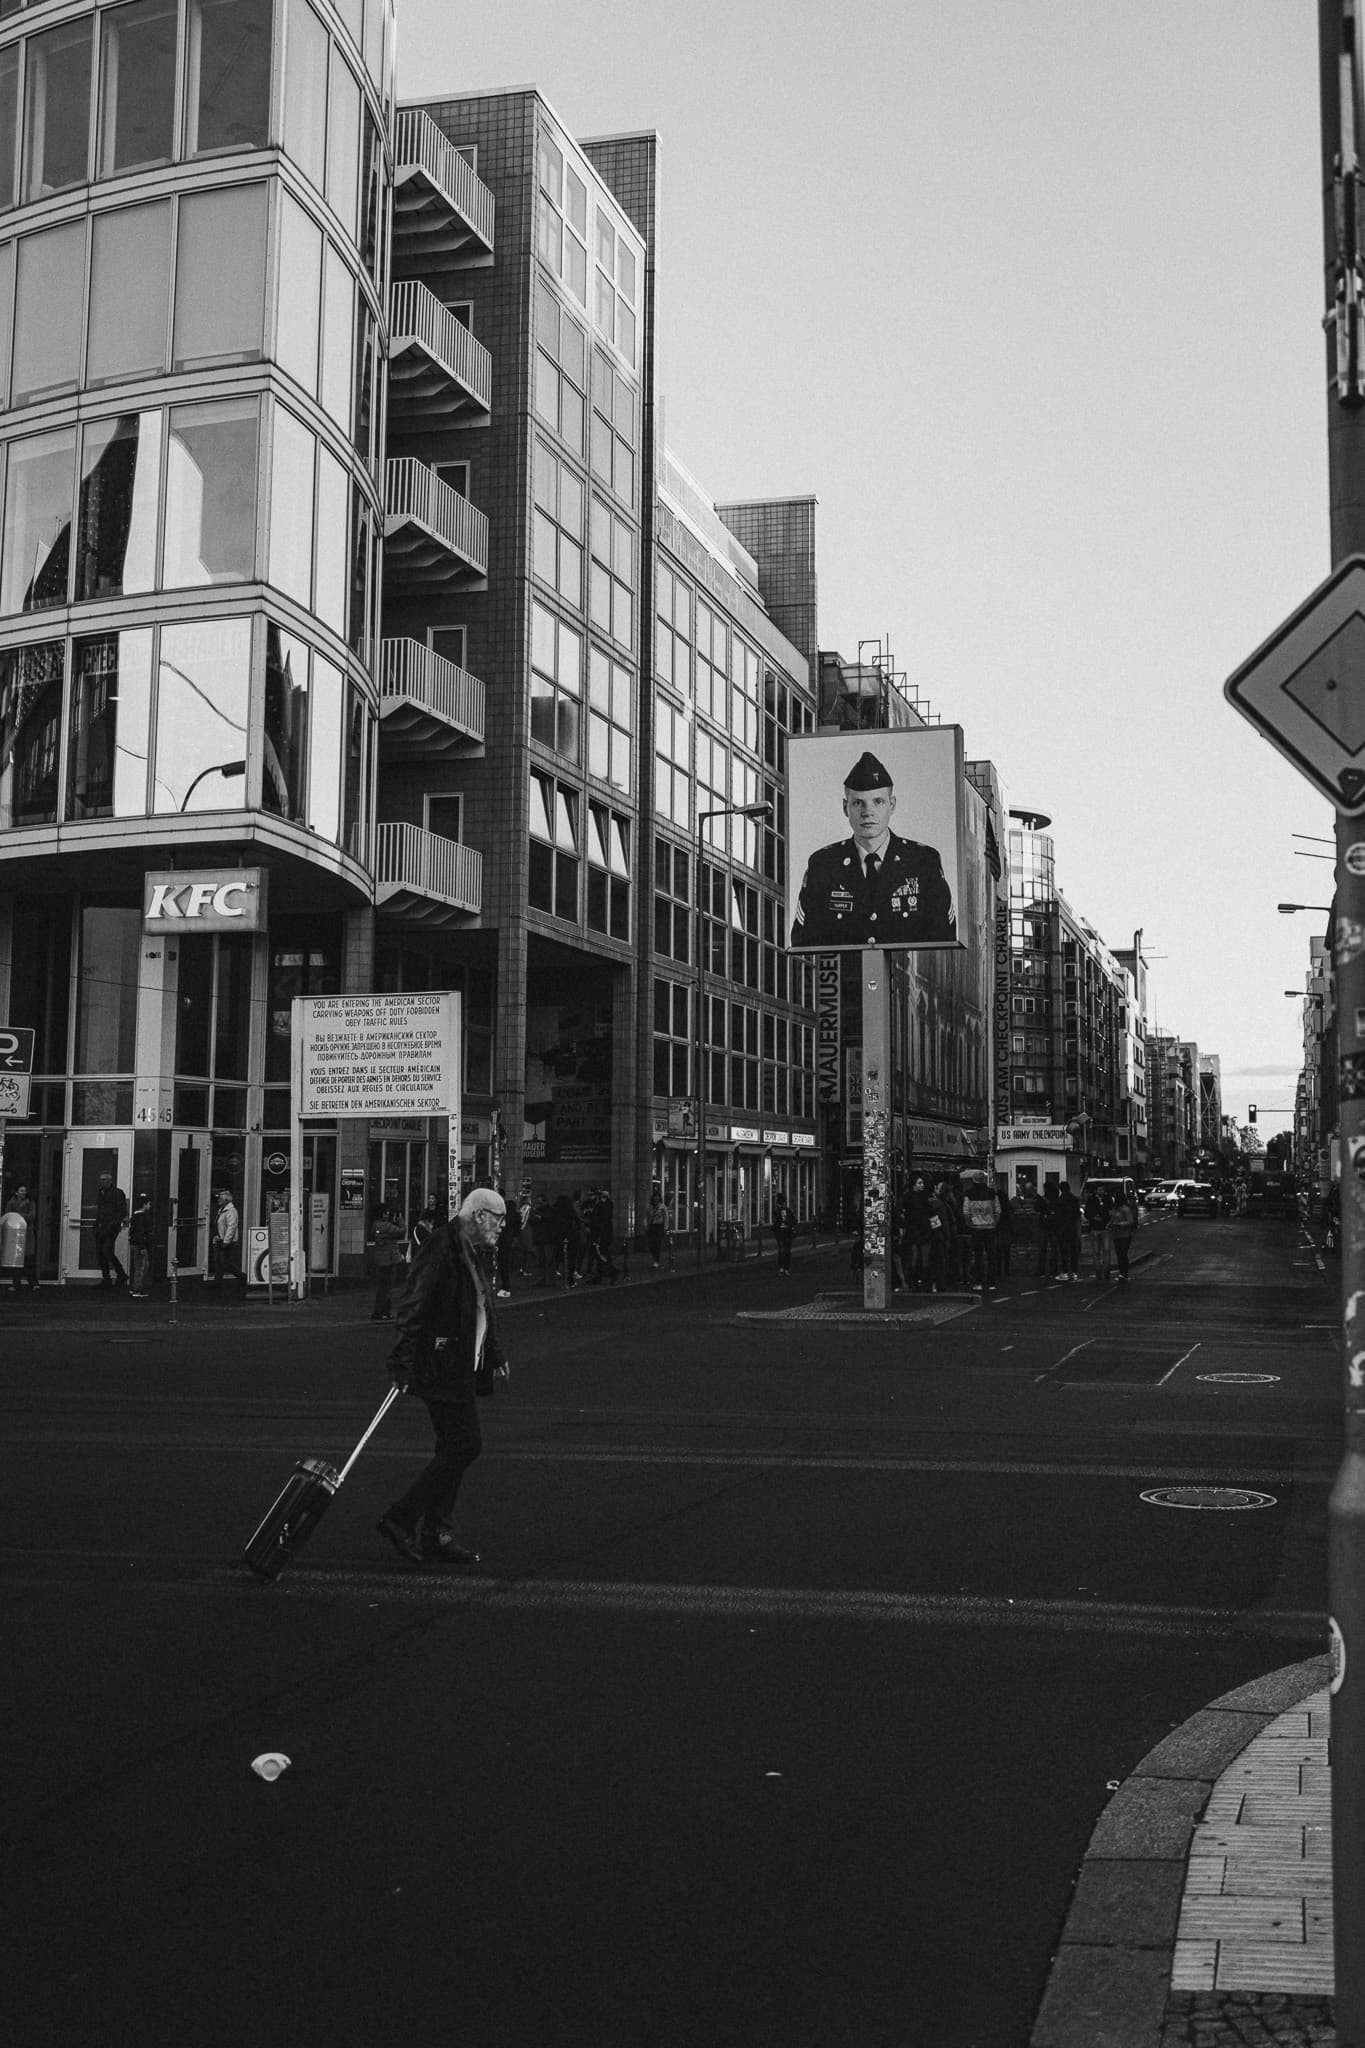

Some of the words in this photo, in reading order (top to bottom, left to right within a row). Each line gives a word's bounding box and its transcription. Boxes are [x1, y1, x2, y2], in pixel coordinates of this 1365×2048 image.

[145, 882, 247, 918] KFC
[996, 905, 1008, 965] CHARLIE
[313, 1001, 326, 1009] YOU
[328, 1000, 339, 1008] ARE
[342, 999, 369, 1008] ENTERING
[372, 998, 382, 1006] THE
[385, 998, 414, 1006] AMERICAN
[417, 997, 440, 1005] SECTOR
[312, 1010, 343, 1018] CARRYING
[345, 1009, 373, 1018] WEAPONS
[375, 1008, 386, 1017] OFF
[390, 1008, 403, 1016] DUTY
[407, 1007, 439, 1015] FORBIDDEN
[996, 970, 1008, 1063] CHECKPOINT
[345, 1018, 360, 1027] OBEY
[363, 1018, 387, 1026] TRAFFIC
[390, 1017, 408, 1025] RULES
[316, 1034, 325, 1042] ВЫ
[360, 1033, 363, 1041] В
[366, 1031, 413, 1041] АМЕРИКАНСКИЙ
[416, 1031, 437, 1039] СЕКТОР
[310, 1044, 330, 1052] НОСИТЬ
[330, 1043, 350, 1051] ОРУЖИЕ
[382, 1042, 386, 1050] В
[424, 1040, 442, 1048] ВРЕМЯ
[360, 1052, 396, 1060] ДОРОЖНЫМ
[398, 1050, 432, 1059] ПРАВИЛАМ
[310, 1067, 326, 1076] VOUS
[328, 1066, 350, 1075] ENTREZ
[352, 1066, 368, 1074] DANS
[370, 1066, 376, 1074] LE
[378, 1065, 405, 1074] SECTEUR
[310, 1076, 330, 1084] DEFENSE
[331, 1076, 336, 1084] DE
[338, 1076, 356, 1084] PORTER
[356, 1076, 366, 1084] DES
[366, 1075, 382, 1083] ARMES
[392, 1074, 412, 1082] DEHORS
[412, 1074, 420, 1082] DU
[421, 1074, 442, 1082] SERVICE
[997, 1067, 1008, 1091] AM
[316, 1085, 345, 1094] OBEISSEZ
[348, 1085, 360, 1093] AUX
[362, 1084, 383, 1092] REGLES
[386, 1084, 392, 1092] DE
[396, 1083, 434, 1092] CIRCULATION
[310, 1100, 319, 1110] SIE
[321, 1100, 348, 1109] BETRETEN
[350, 1100, 362, 1108] DEN
[364, 1098, 415, 1108] AMERIKANISCHEN
[418, 1098, 440, 1108] SEKTOR
[160, 1108, 172, 1122] 45
[1001, 1130, 1011, 1140] US
[1013, 1130, 1030, 1140] ARMY
[1032, 1130, 1068, 1139] CHECKPOINT
